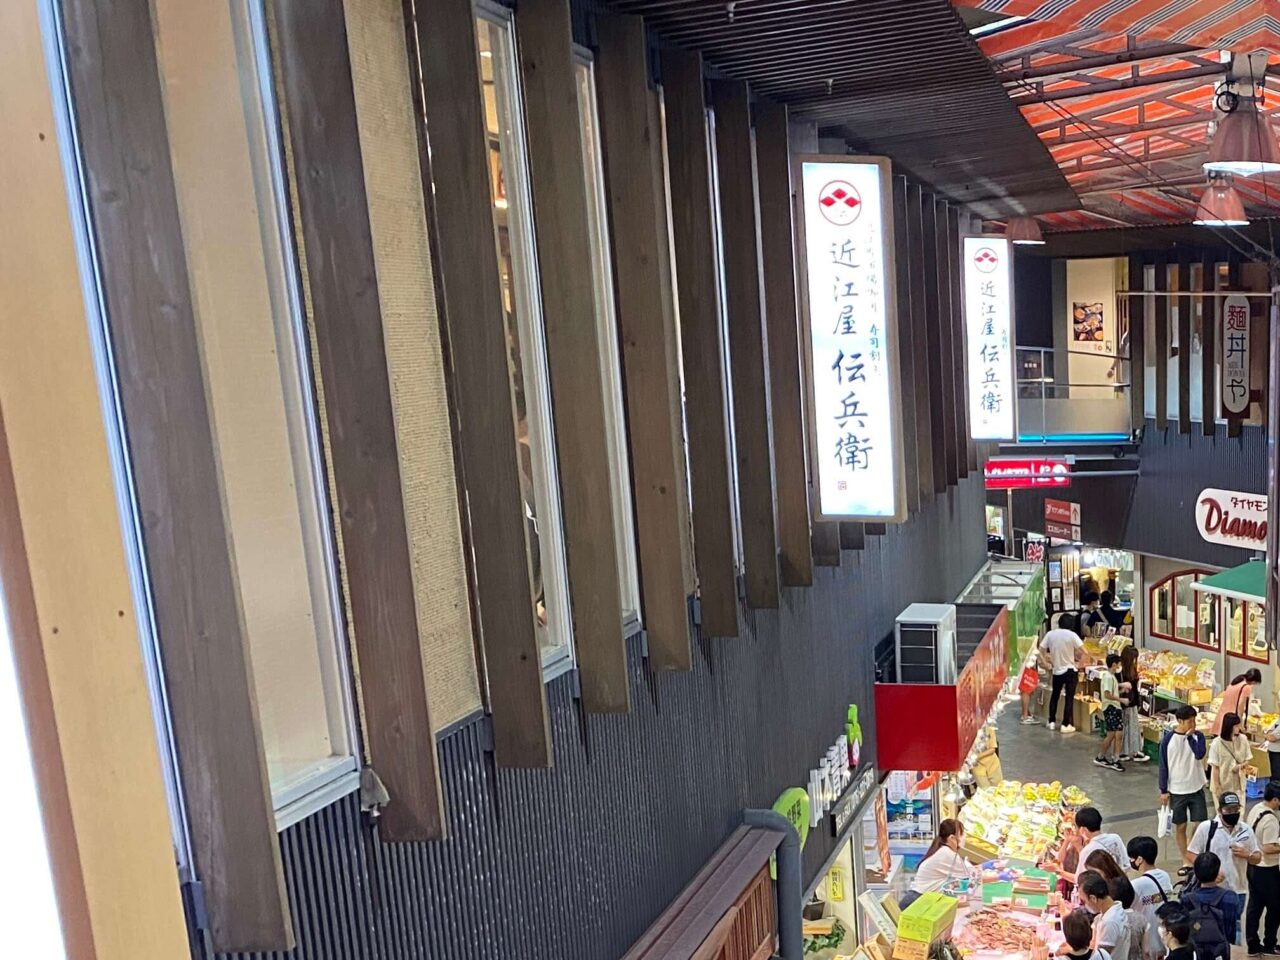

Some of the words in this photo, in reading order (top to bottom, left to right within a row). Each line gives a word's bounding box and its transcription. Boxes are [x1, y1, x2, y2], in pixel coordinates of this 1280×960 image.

[831, 238, 874, 472] 近江屋伝兵衛
[979, 280, 1003, 413] 近江屋伝兵衛
[1200, 498, 1268, 541] Diamo
